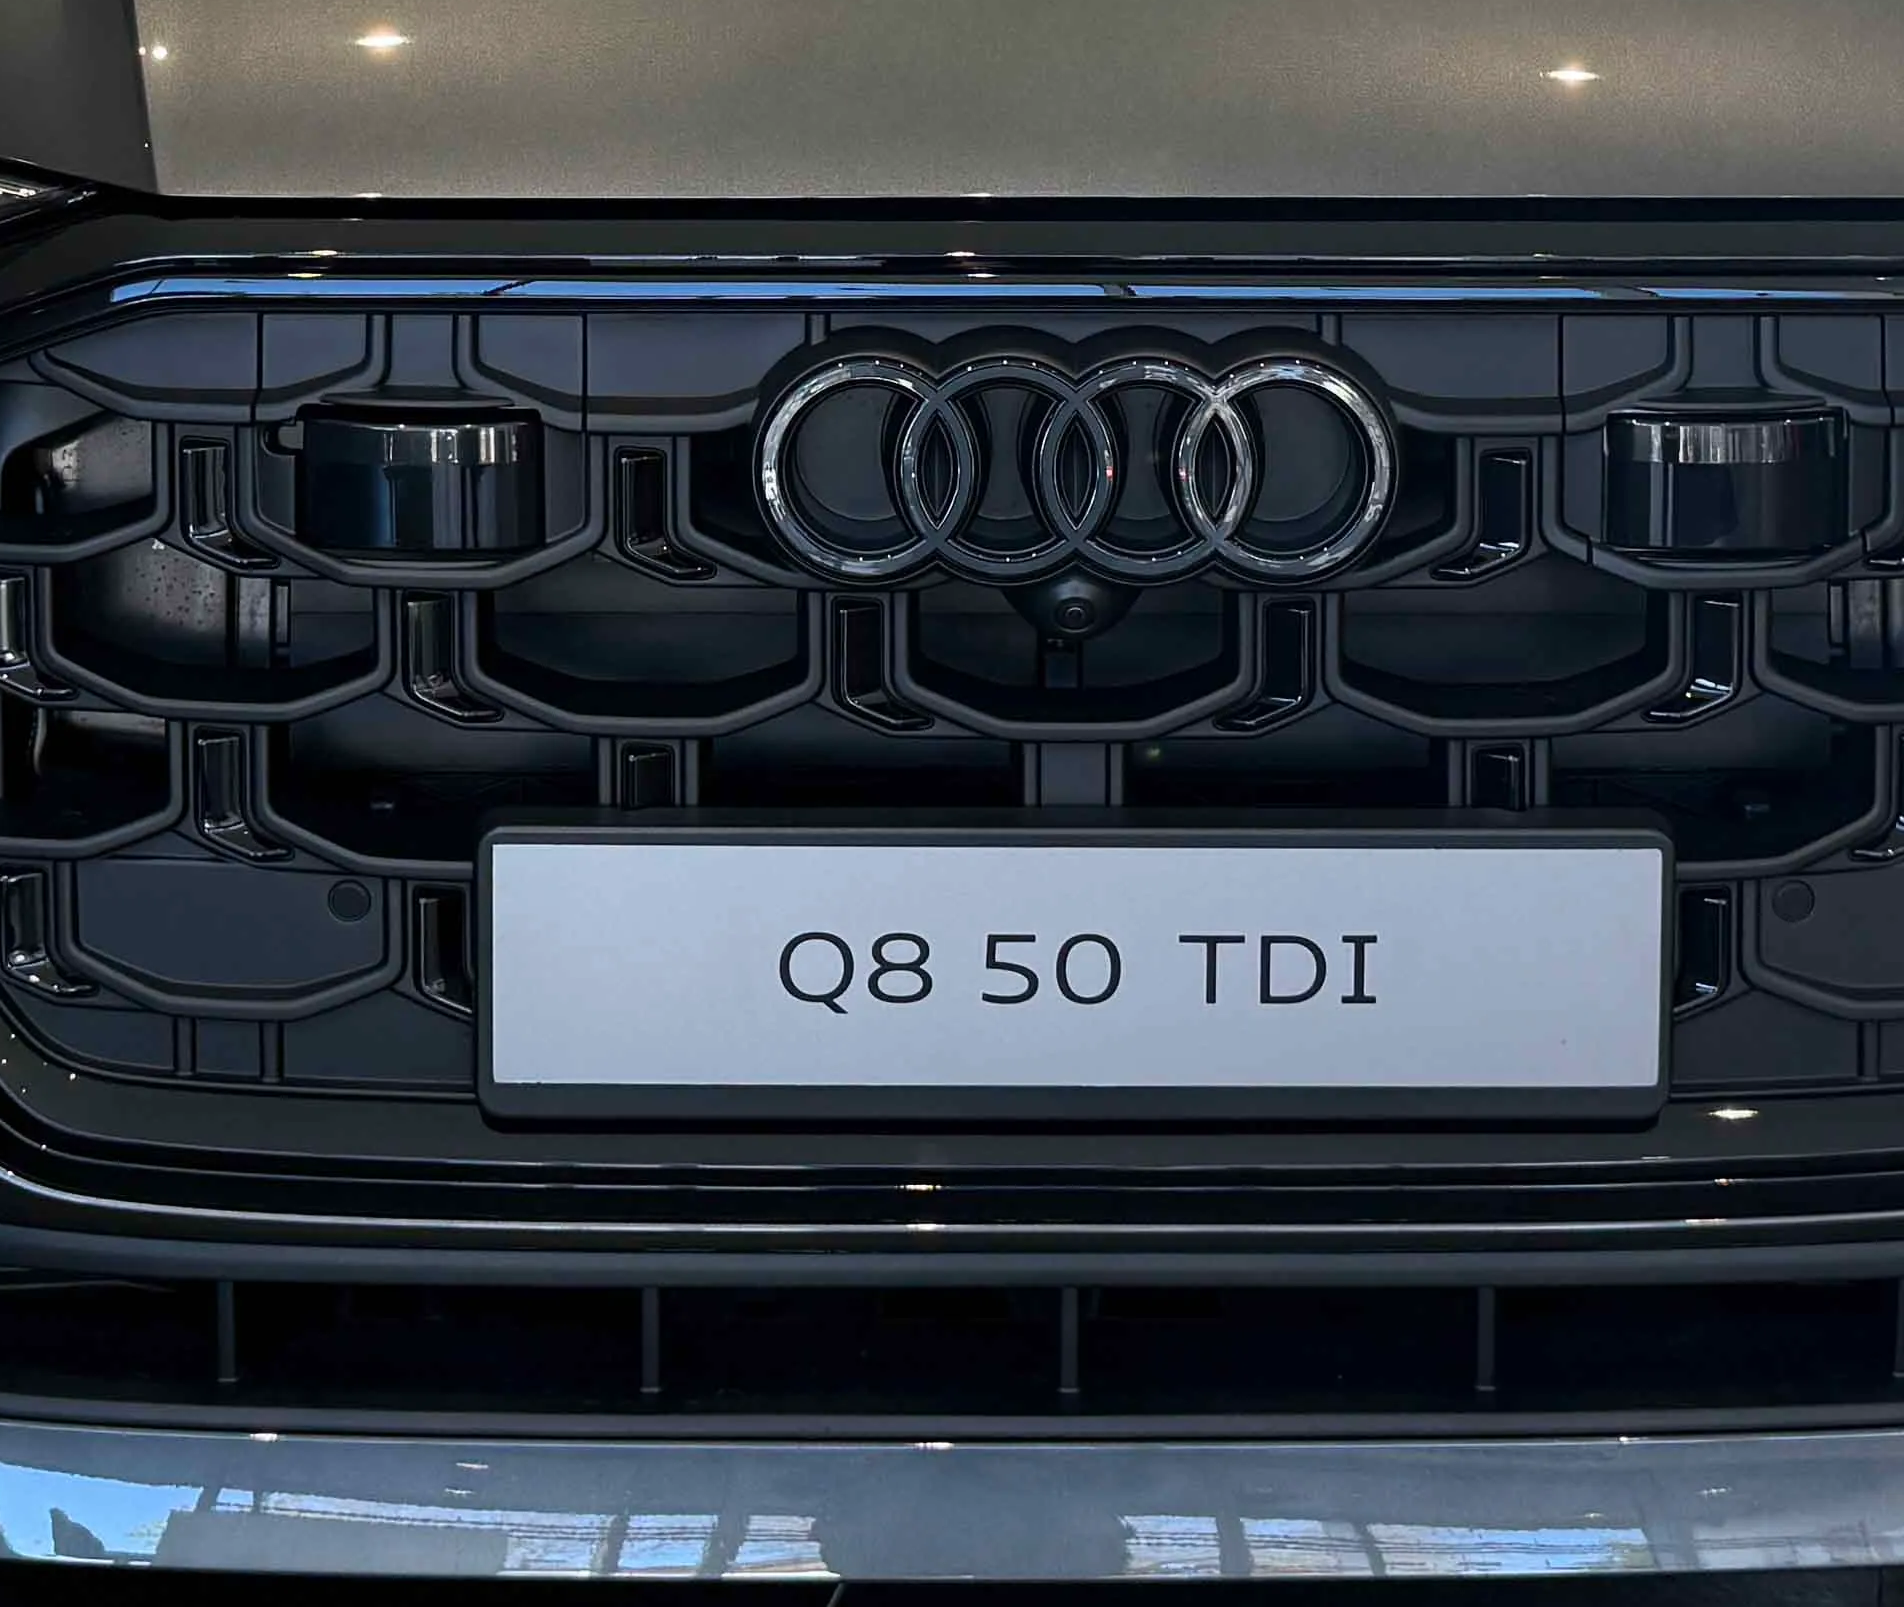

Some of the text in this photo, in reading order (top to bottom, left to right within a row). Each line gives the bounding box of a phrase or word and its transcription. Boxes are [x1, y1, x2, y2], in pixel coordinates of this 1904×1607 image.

[779, 932, 1378, 1014] Q8 50 TDI
